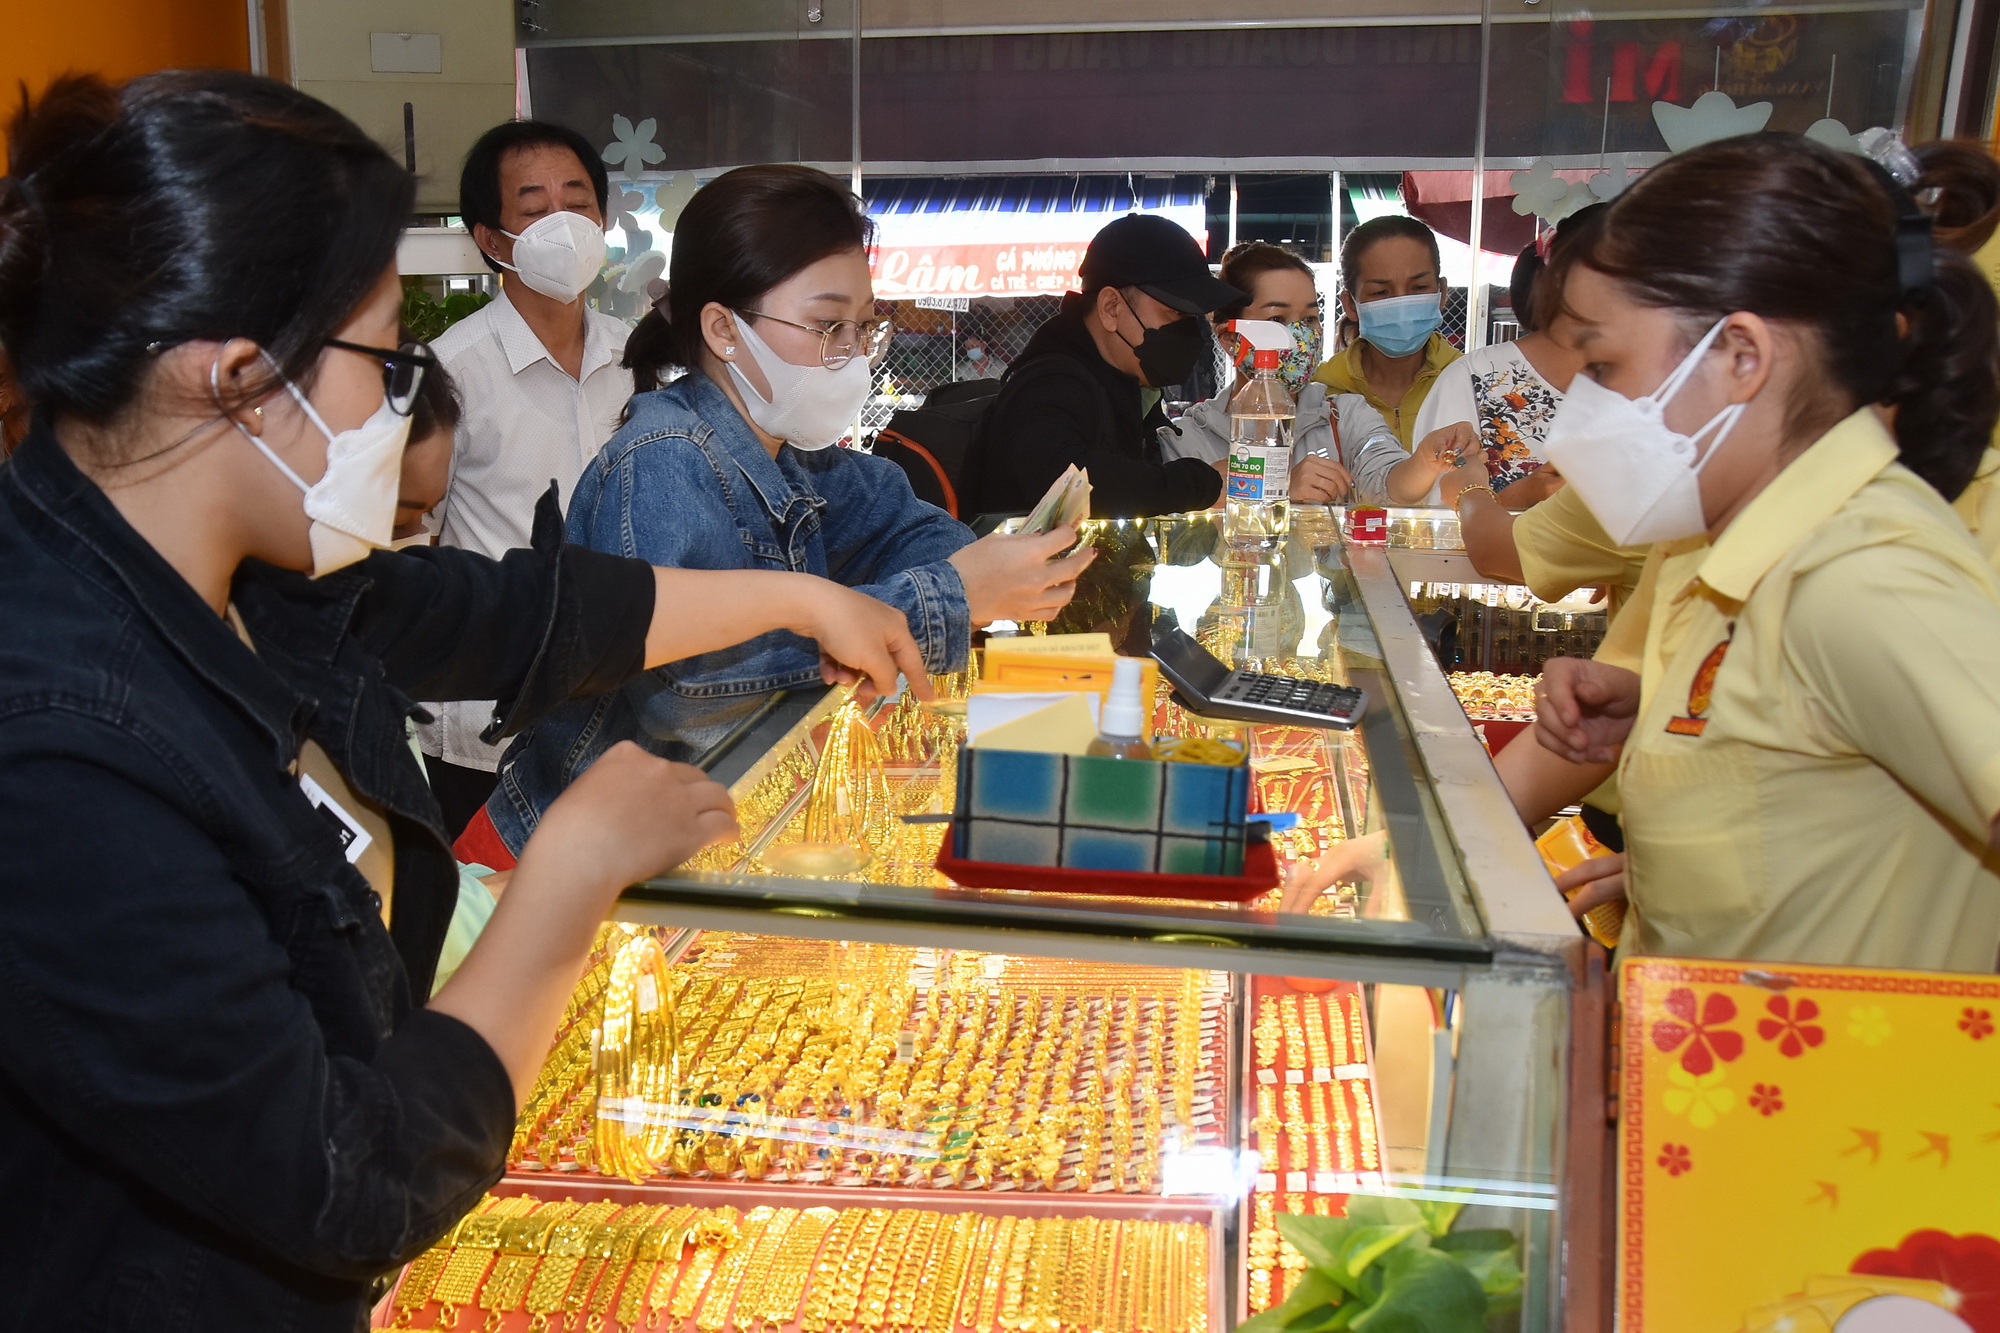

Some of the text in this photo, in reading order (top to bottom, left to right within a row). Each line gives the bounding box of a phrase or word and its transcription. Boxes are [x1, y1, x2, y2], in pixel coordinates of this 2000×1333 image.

[871, 250, 983, 293] Lâm
[997, 247, 1017, 272] CÁ
[990, 273, 1005, 290] CÁ
[1036, 272, 1065, 290] CHÉP
